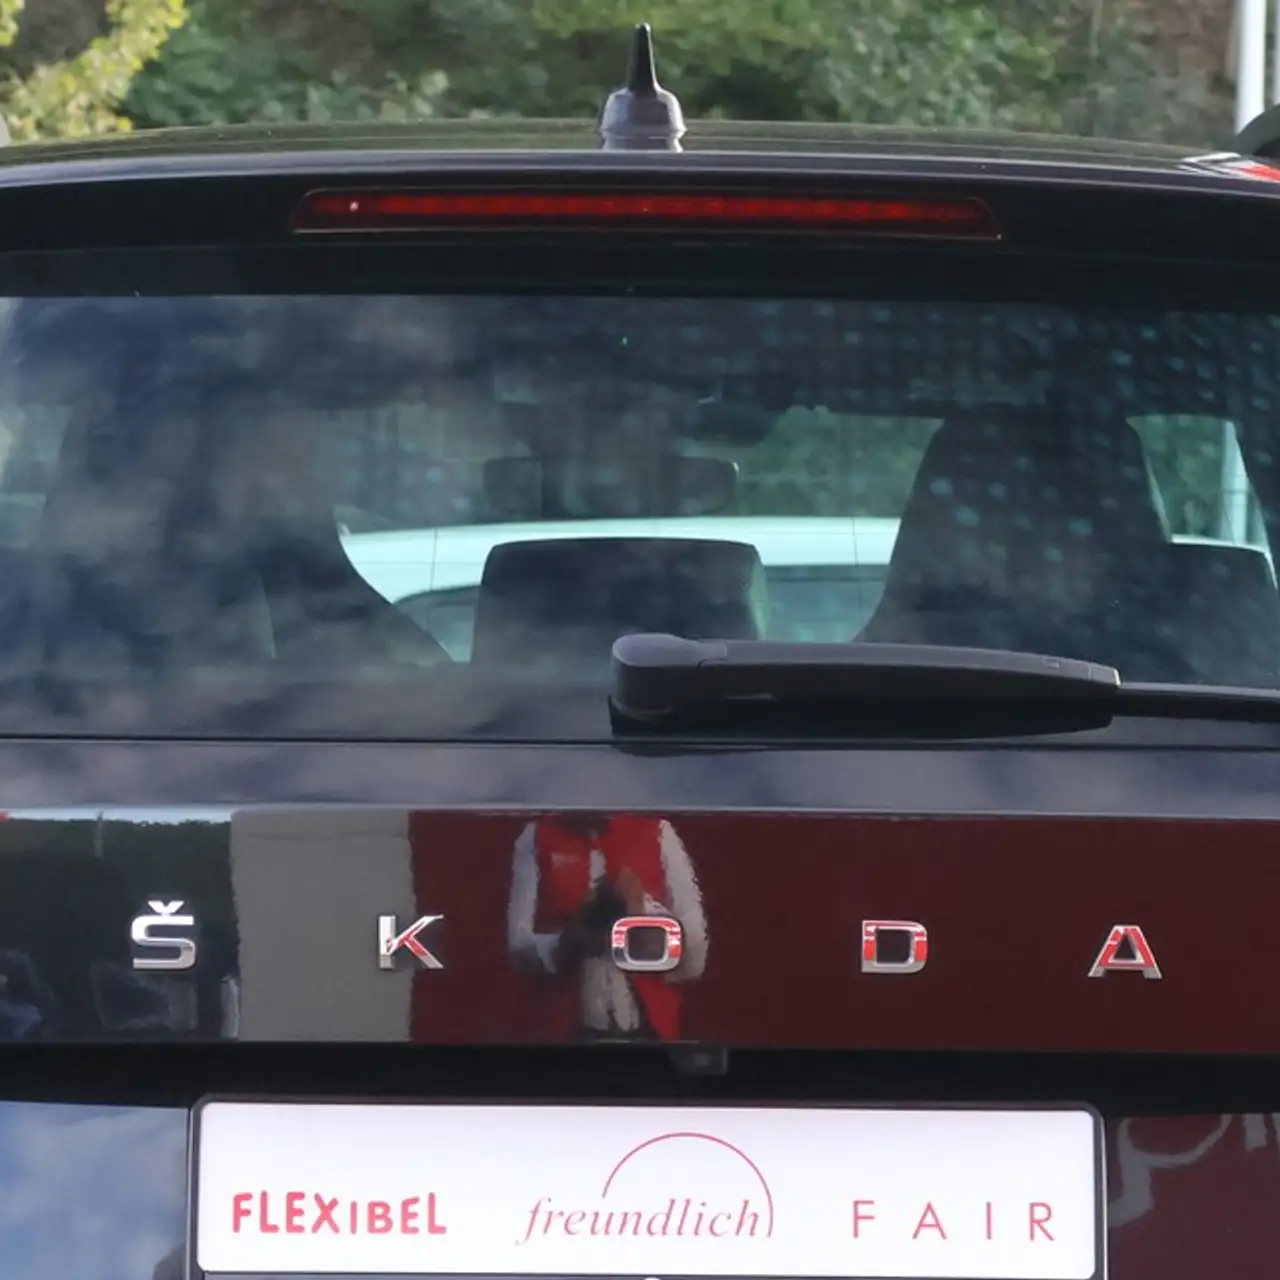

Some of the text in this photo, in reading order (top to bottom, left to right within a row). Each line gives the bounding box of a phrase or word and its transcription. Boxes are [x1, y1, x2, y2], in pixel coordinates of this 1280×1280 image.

[130, 898, 1163, 978] ŠKODA
[231, 1190, 1055, 1246] FLEXIBEL freundlich FAIR
